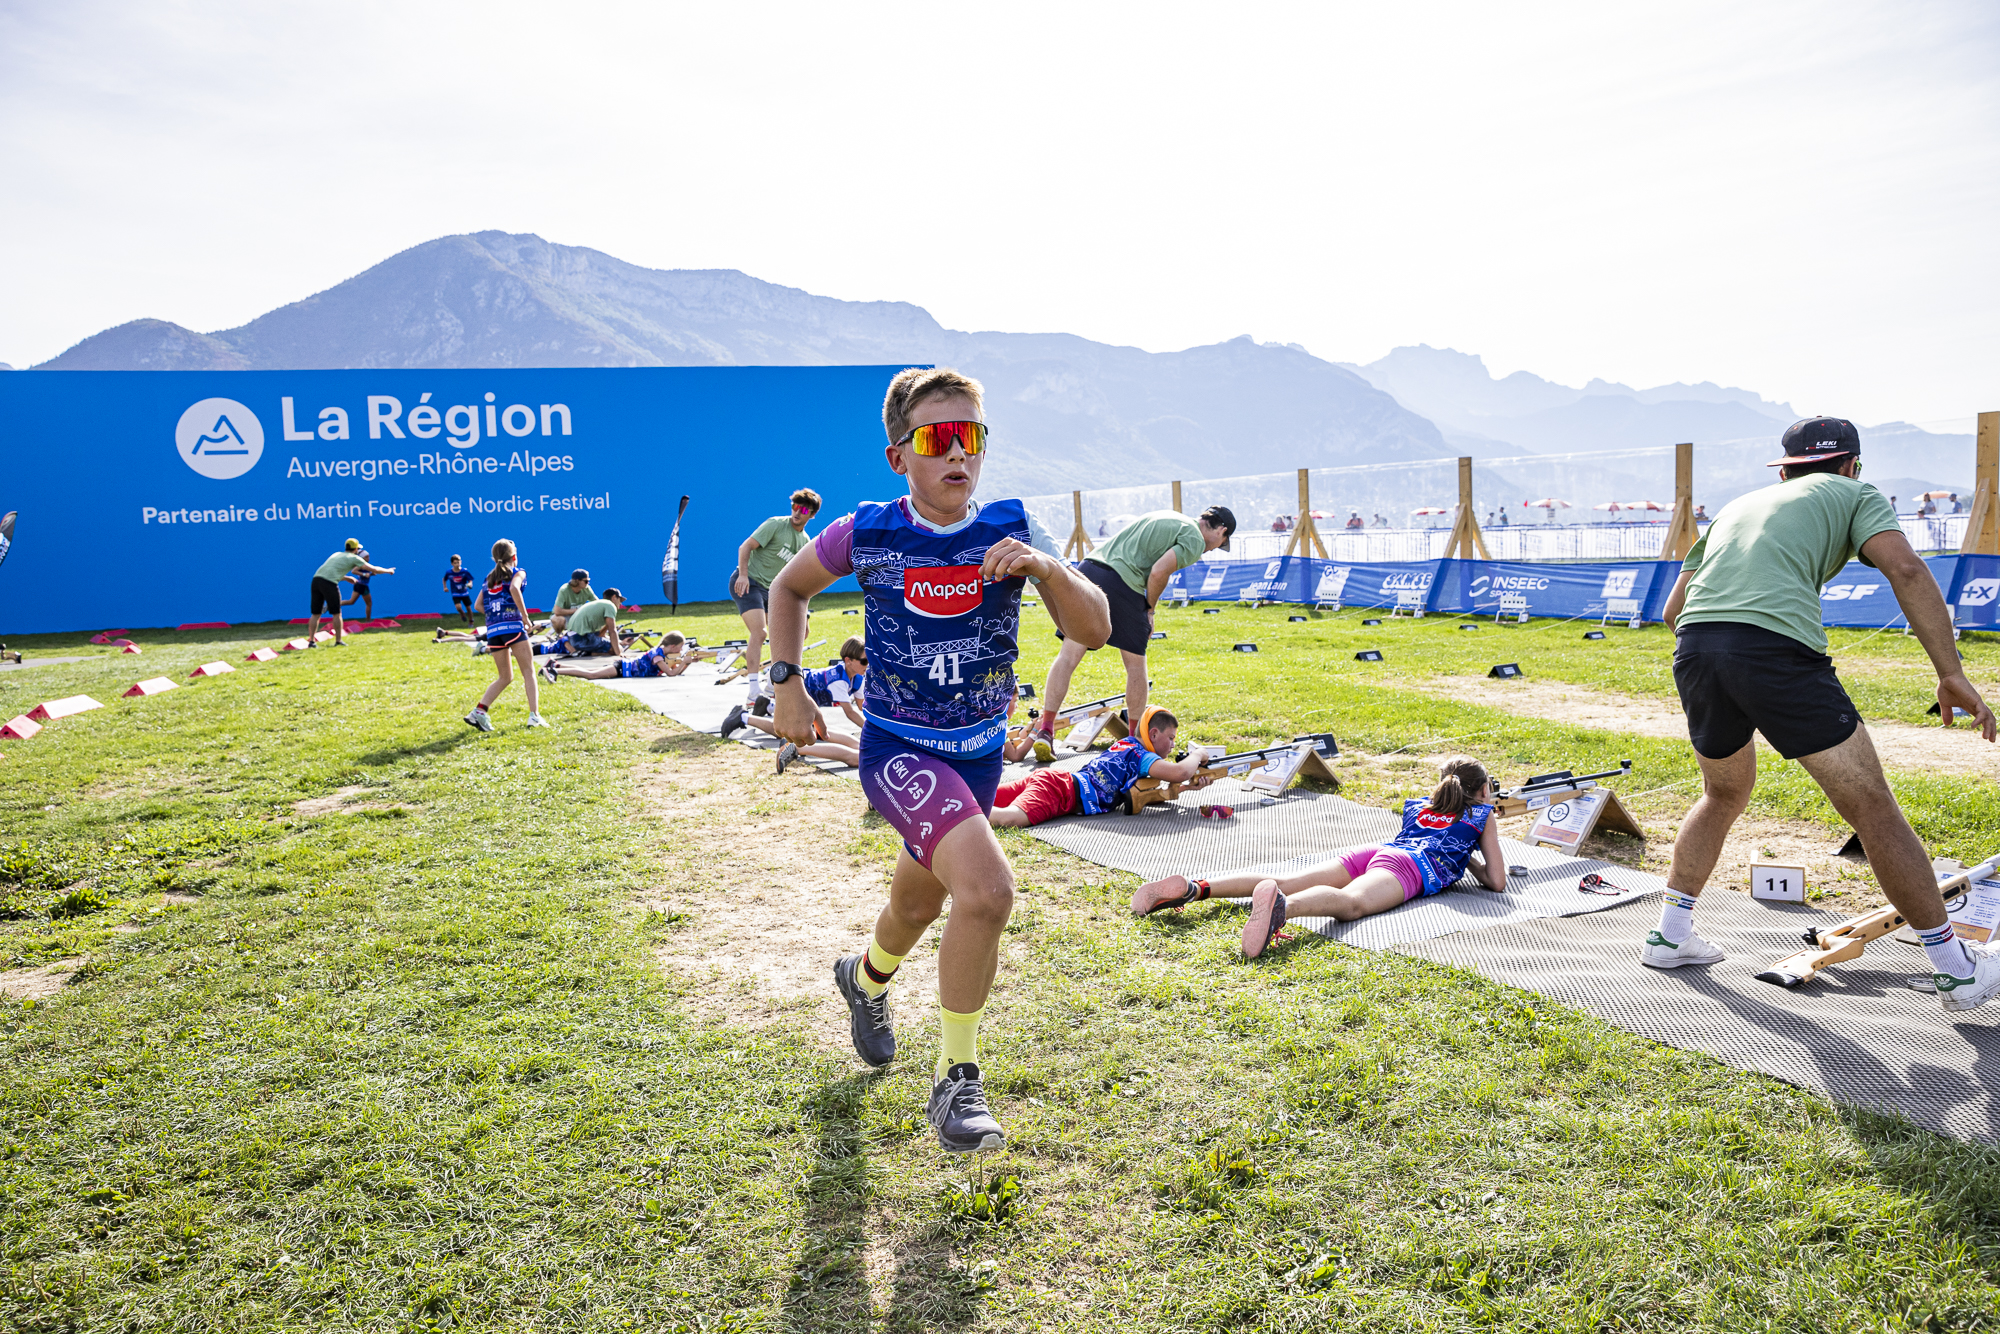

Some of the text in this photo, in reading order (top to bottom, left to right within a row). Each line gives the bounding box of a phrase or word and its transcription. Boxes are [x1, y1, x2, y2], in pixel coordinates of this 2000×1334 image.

[282, 392, 572, 449] La Région
[287, 450, 574, 481] Auvergne-Rhône-Alpes
[142, 492, 610, 524] Partenaire du Martin Fourcade Nordic Festival
[909, 579, 978, 600] Maped
[1492, 576, 1549, 590] INSEEC
[1489, 590, 1521, 598] SPORT
[928, 652, 964, 686] 41
[961, 731, 988, 752] NORDIC
[892, 760, 910, 780] SKI
[907, 781, 925, 800] 25
[1765, 878, 1788, 892] 11
